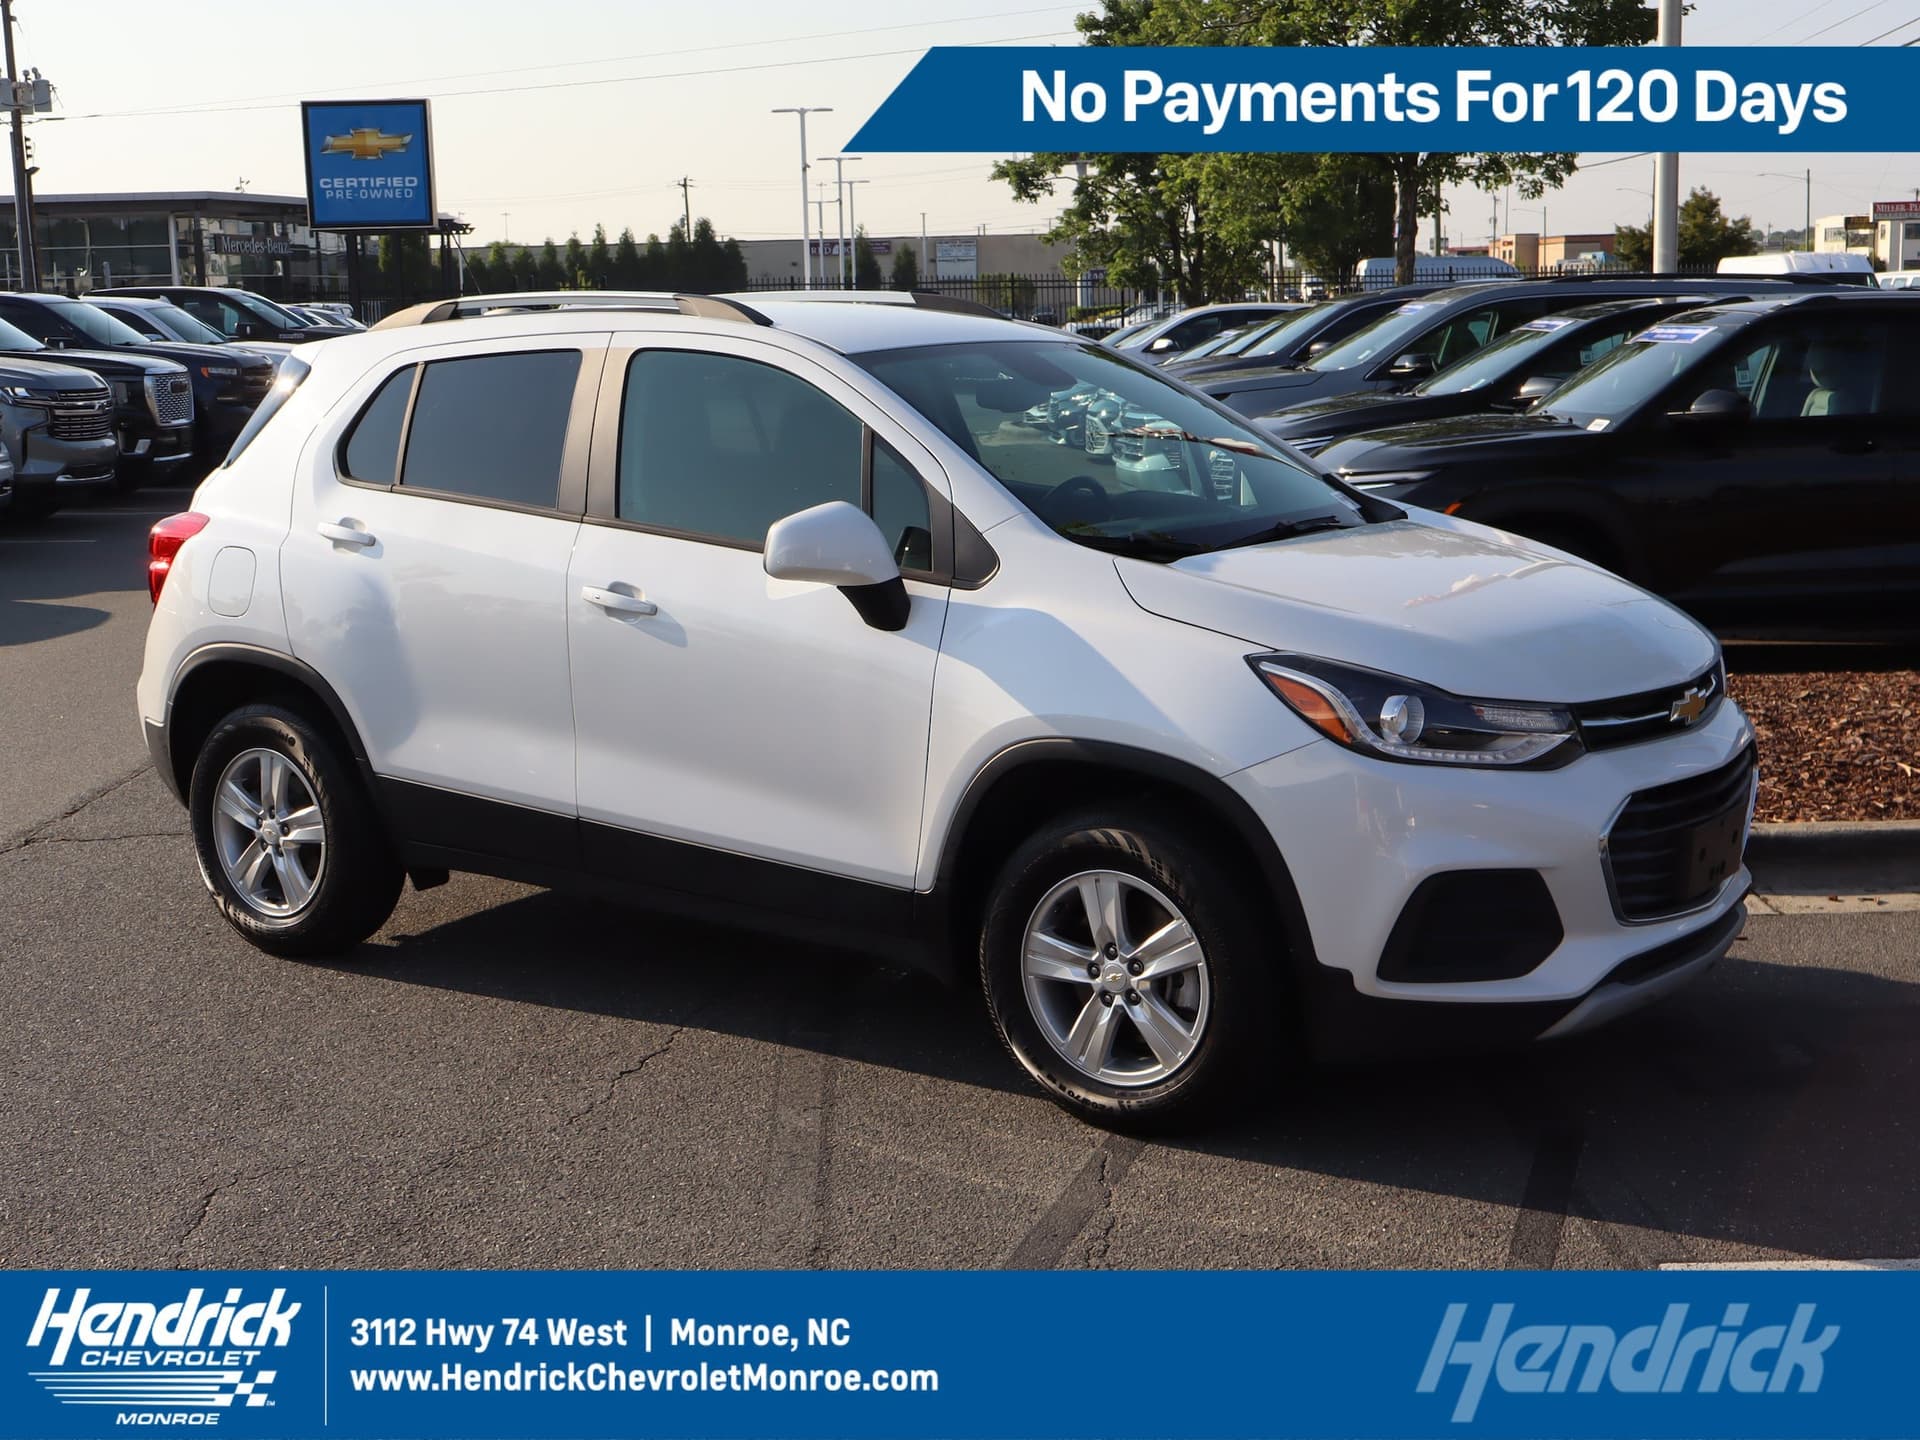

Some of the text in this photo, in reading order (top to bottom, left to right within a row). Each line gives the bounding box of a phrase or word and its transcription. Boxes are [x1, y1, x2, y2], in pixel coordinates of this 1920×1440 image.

[320, 176, 418, 188] CERTIFIED
[325, 188, 413, 199] PRE-OWNED
[222, 236, 289, 254] Mercedes-Benz
